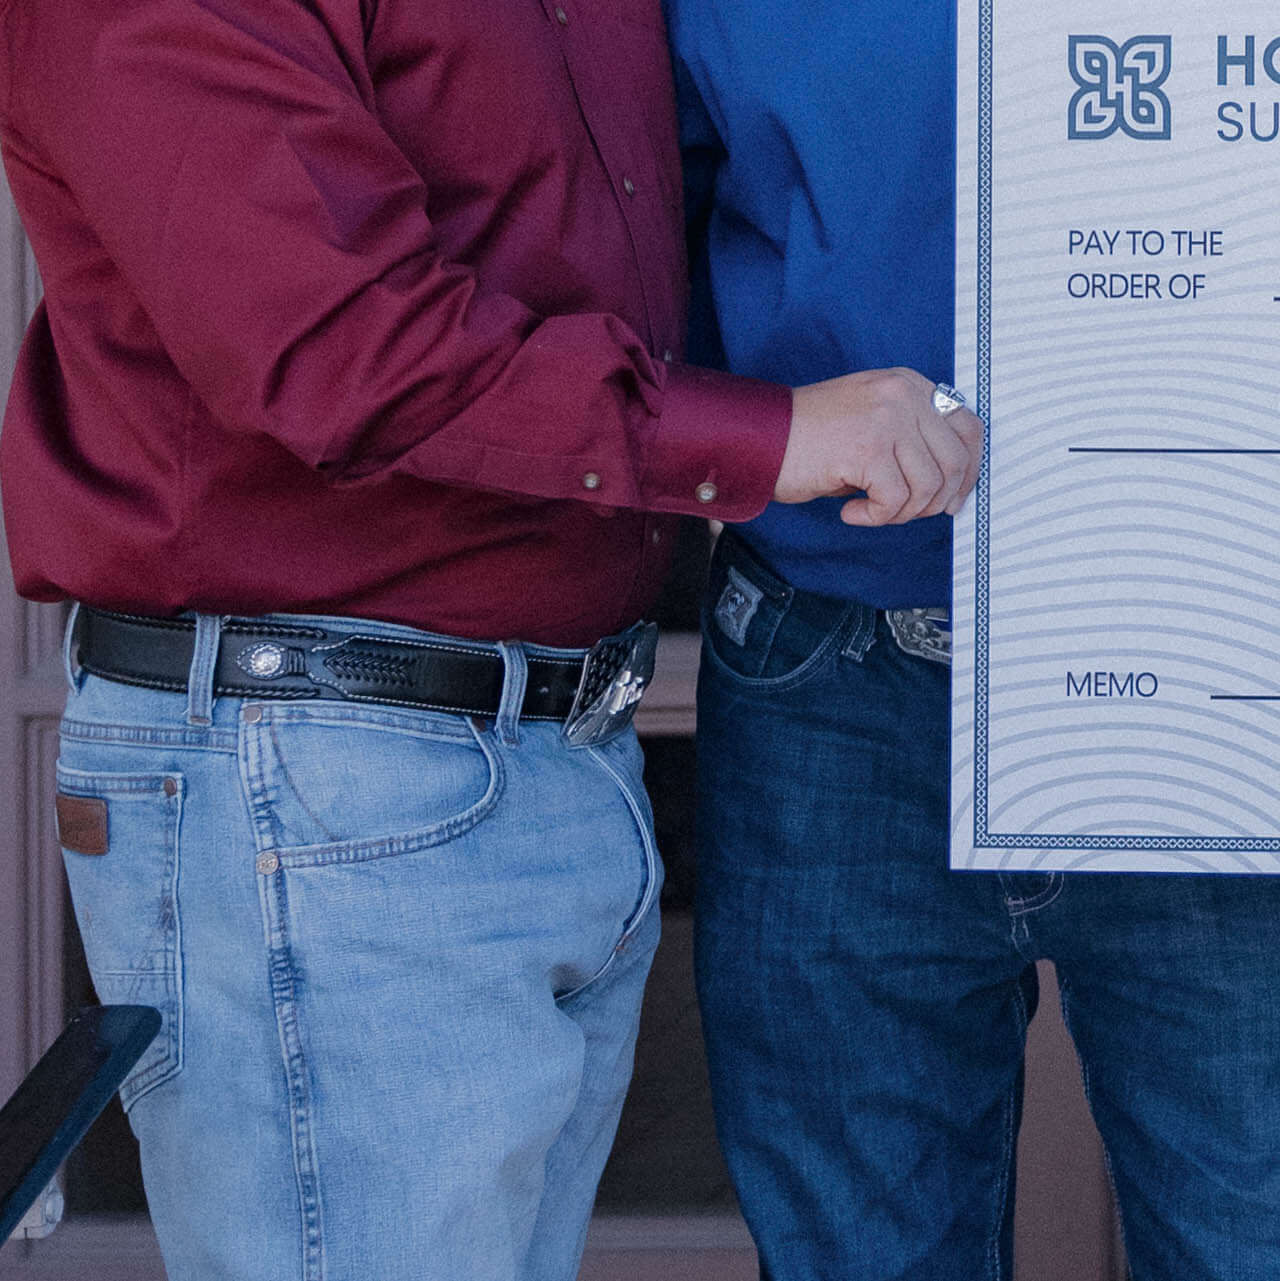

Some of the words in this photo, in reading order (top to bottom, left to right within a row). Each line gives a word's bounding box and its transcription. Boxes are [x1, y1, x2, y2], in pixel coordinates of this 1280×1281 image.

[1067, 228, 1121, 256] PAY
[1124, 229, 1166, 257] TO
[1170, 229, 1224, 257] THE
[1066, 271, 1163, 300] ORDER
[1168, 271, 1207, 301] OF
[1065, 670, 1160, 699] MEMO
